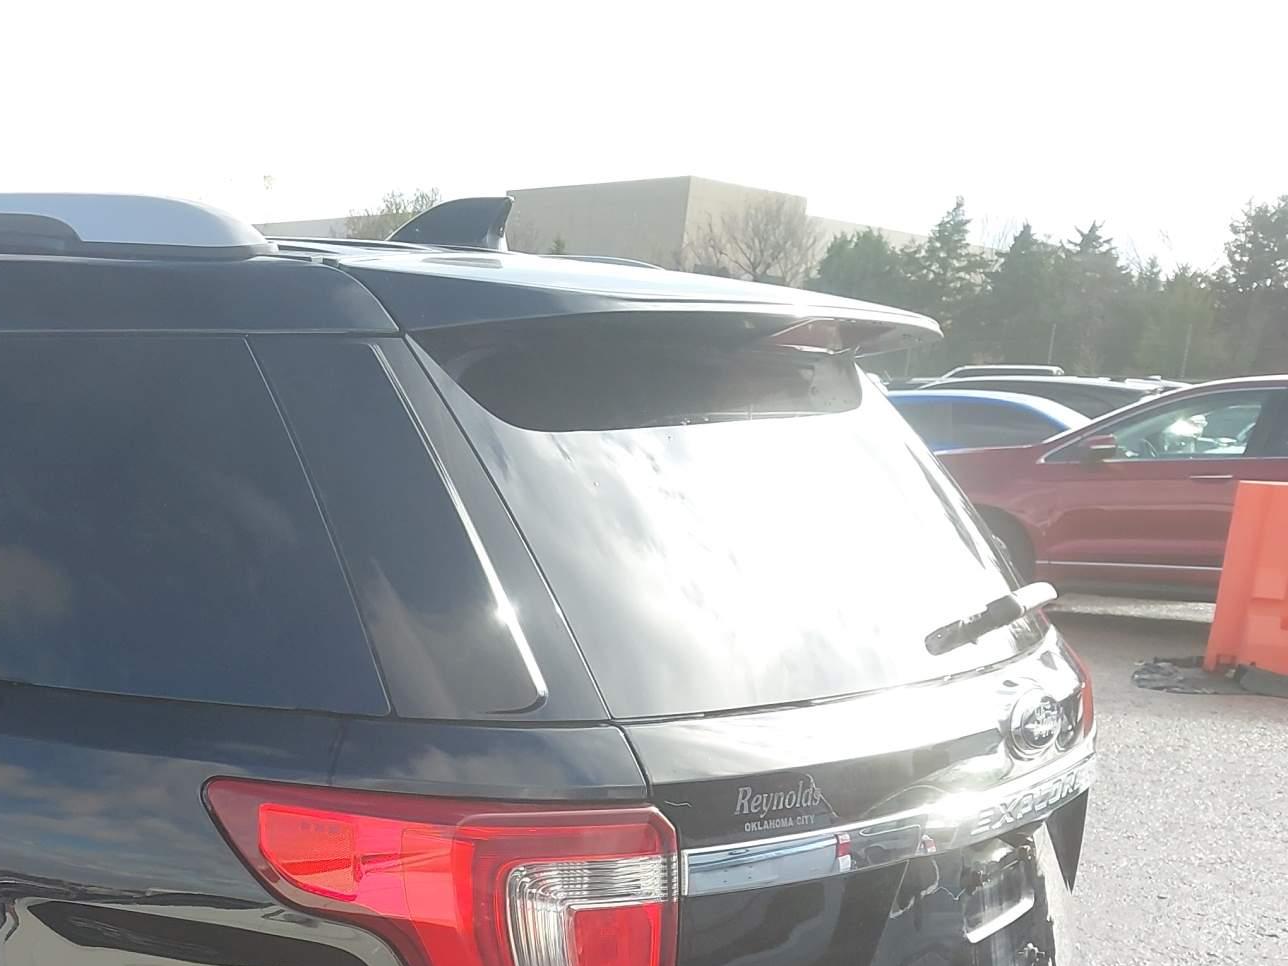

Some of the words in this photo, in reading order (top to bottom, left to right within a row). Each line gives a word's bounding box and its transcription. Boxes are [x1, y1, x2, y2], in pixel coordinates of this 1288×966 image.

[734, 780, 822, 818] Reynolds
[744, 817, 794, 832] OKLAHOMA
[796, 814, 816, 826] CITY
